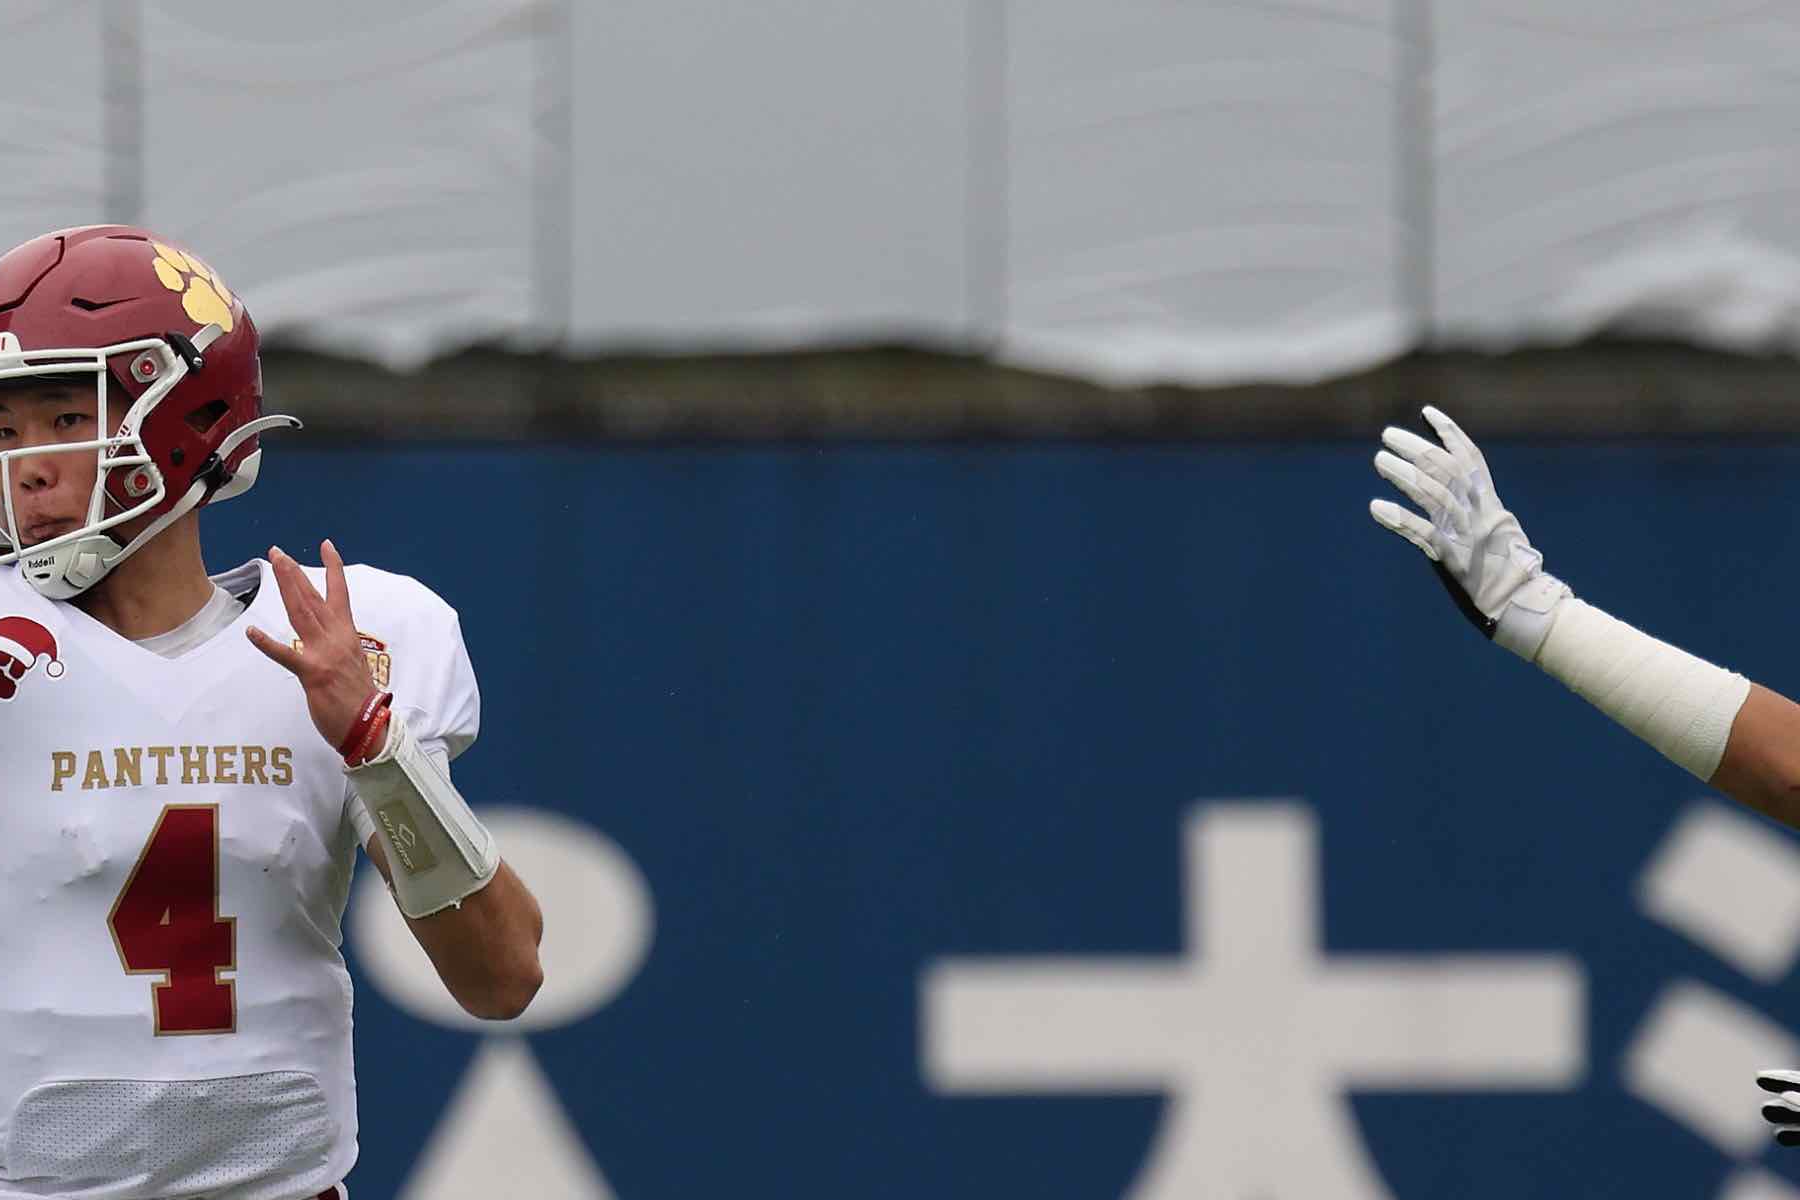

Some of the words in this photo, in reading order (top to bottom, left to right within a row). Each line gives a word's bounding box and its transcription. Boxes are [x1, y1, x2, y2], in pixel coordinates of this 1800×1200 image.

[28, 556, 55, 568] Riddell
[51, 746, 294, 791] PANTHERS
[106, 803, 237, 1037] 4
